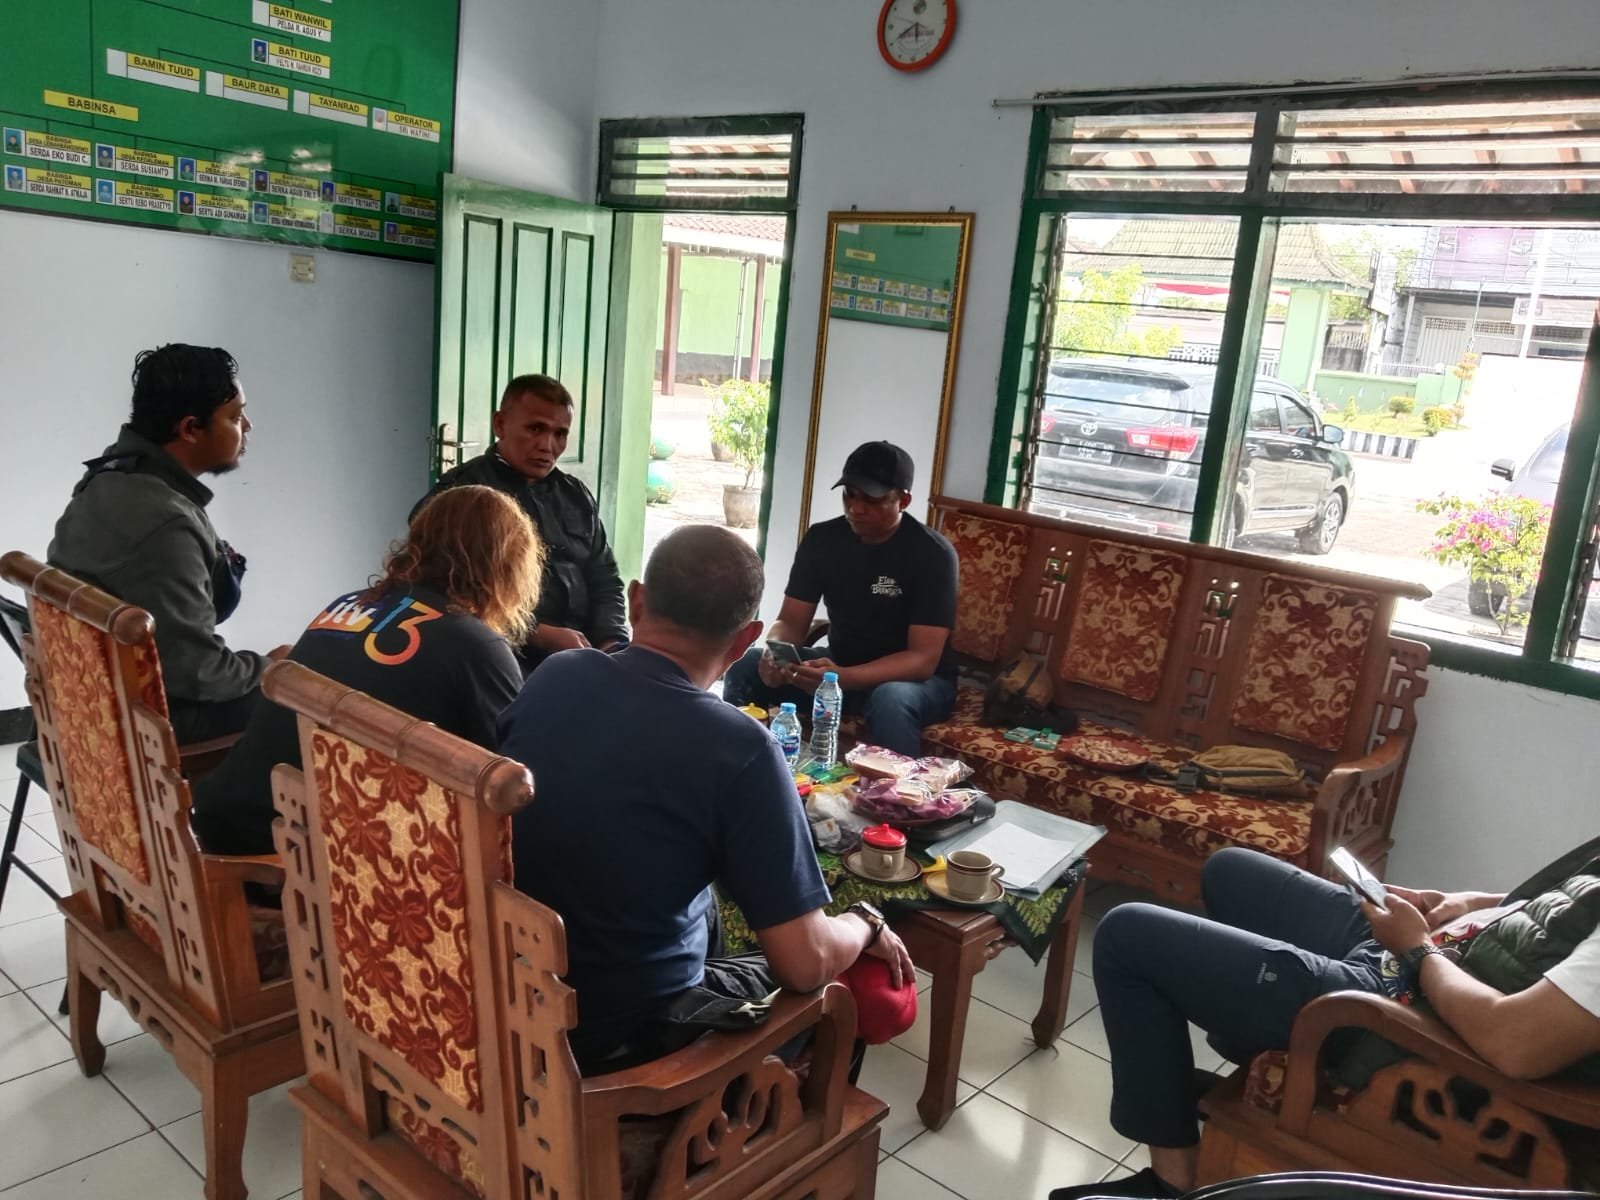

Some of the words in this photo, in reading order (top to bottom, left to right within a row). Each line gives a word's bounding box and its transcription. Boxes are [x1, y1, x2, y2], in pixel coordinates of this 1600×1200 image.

[273, 6, 293, 18] BATI
[295, 12, 328, 28] WANWIL
[302, 27, 316, 36] AGUS
[278, 46, 297, 58] BATI
[299, 51, 321, 63] TUUD
[133, 56, 165, 71] BAMIN
[168, 64, 193, 77] TUUD
[232, 78, 256, 90] BAUR
[259, 84, 280, 96] DATA
[68, 97, 116, 115] BABINSA
[319, 97, 359, 112] TAYANRAD
[395, 114, 433, 129] OPERATOR
[30, 147, 50, 158] SERDA
[52, 150, 64, 160] EKO
[66, 153, 80, 163] BUDI
[121, 161, 139, 172] SERDA
[141, 165, 169, 177] SUSIANTO
[30, 183, 45, 192] SERDA
